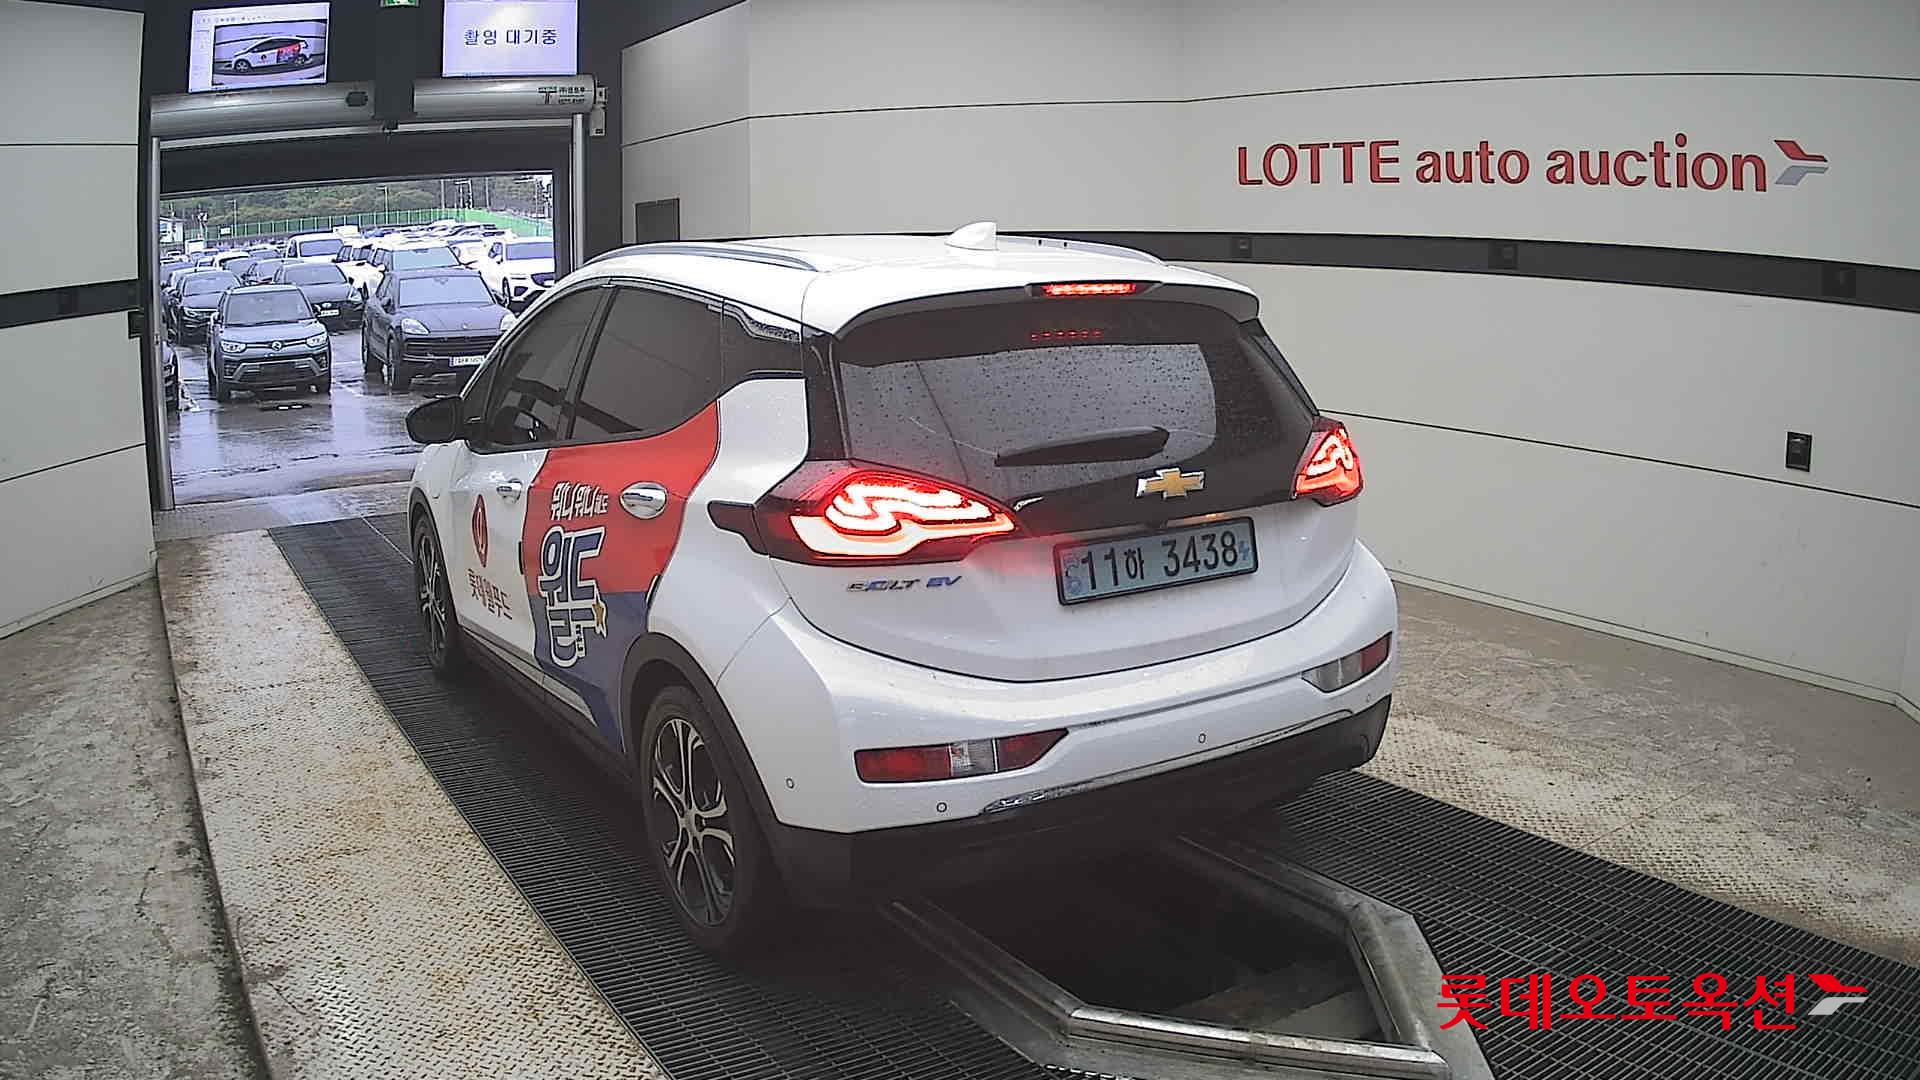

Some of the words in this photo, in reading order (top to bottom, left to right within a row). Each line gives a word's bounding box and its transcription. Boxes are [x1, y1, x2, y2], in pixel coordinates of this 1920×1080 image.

[464, 28, 497, 46] 촬영
[506, 28, 558, 47] 대기중
[1238, 140, 1400, 186] LOTTE
[1415, 141, 1530, 185] auto
[1546, 133, 1767, 192] auction
[1080, 547, 1146, 591] 11하
[1161, 530, 1239, 577] 3438
[926, 575, 962, 588] EV
